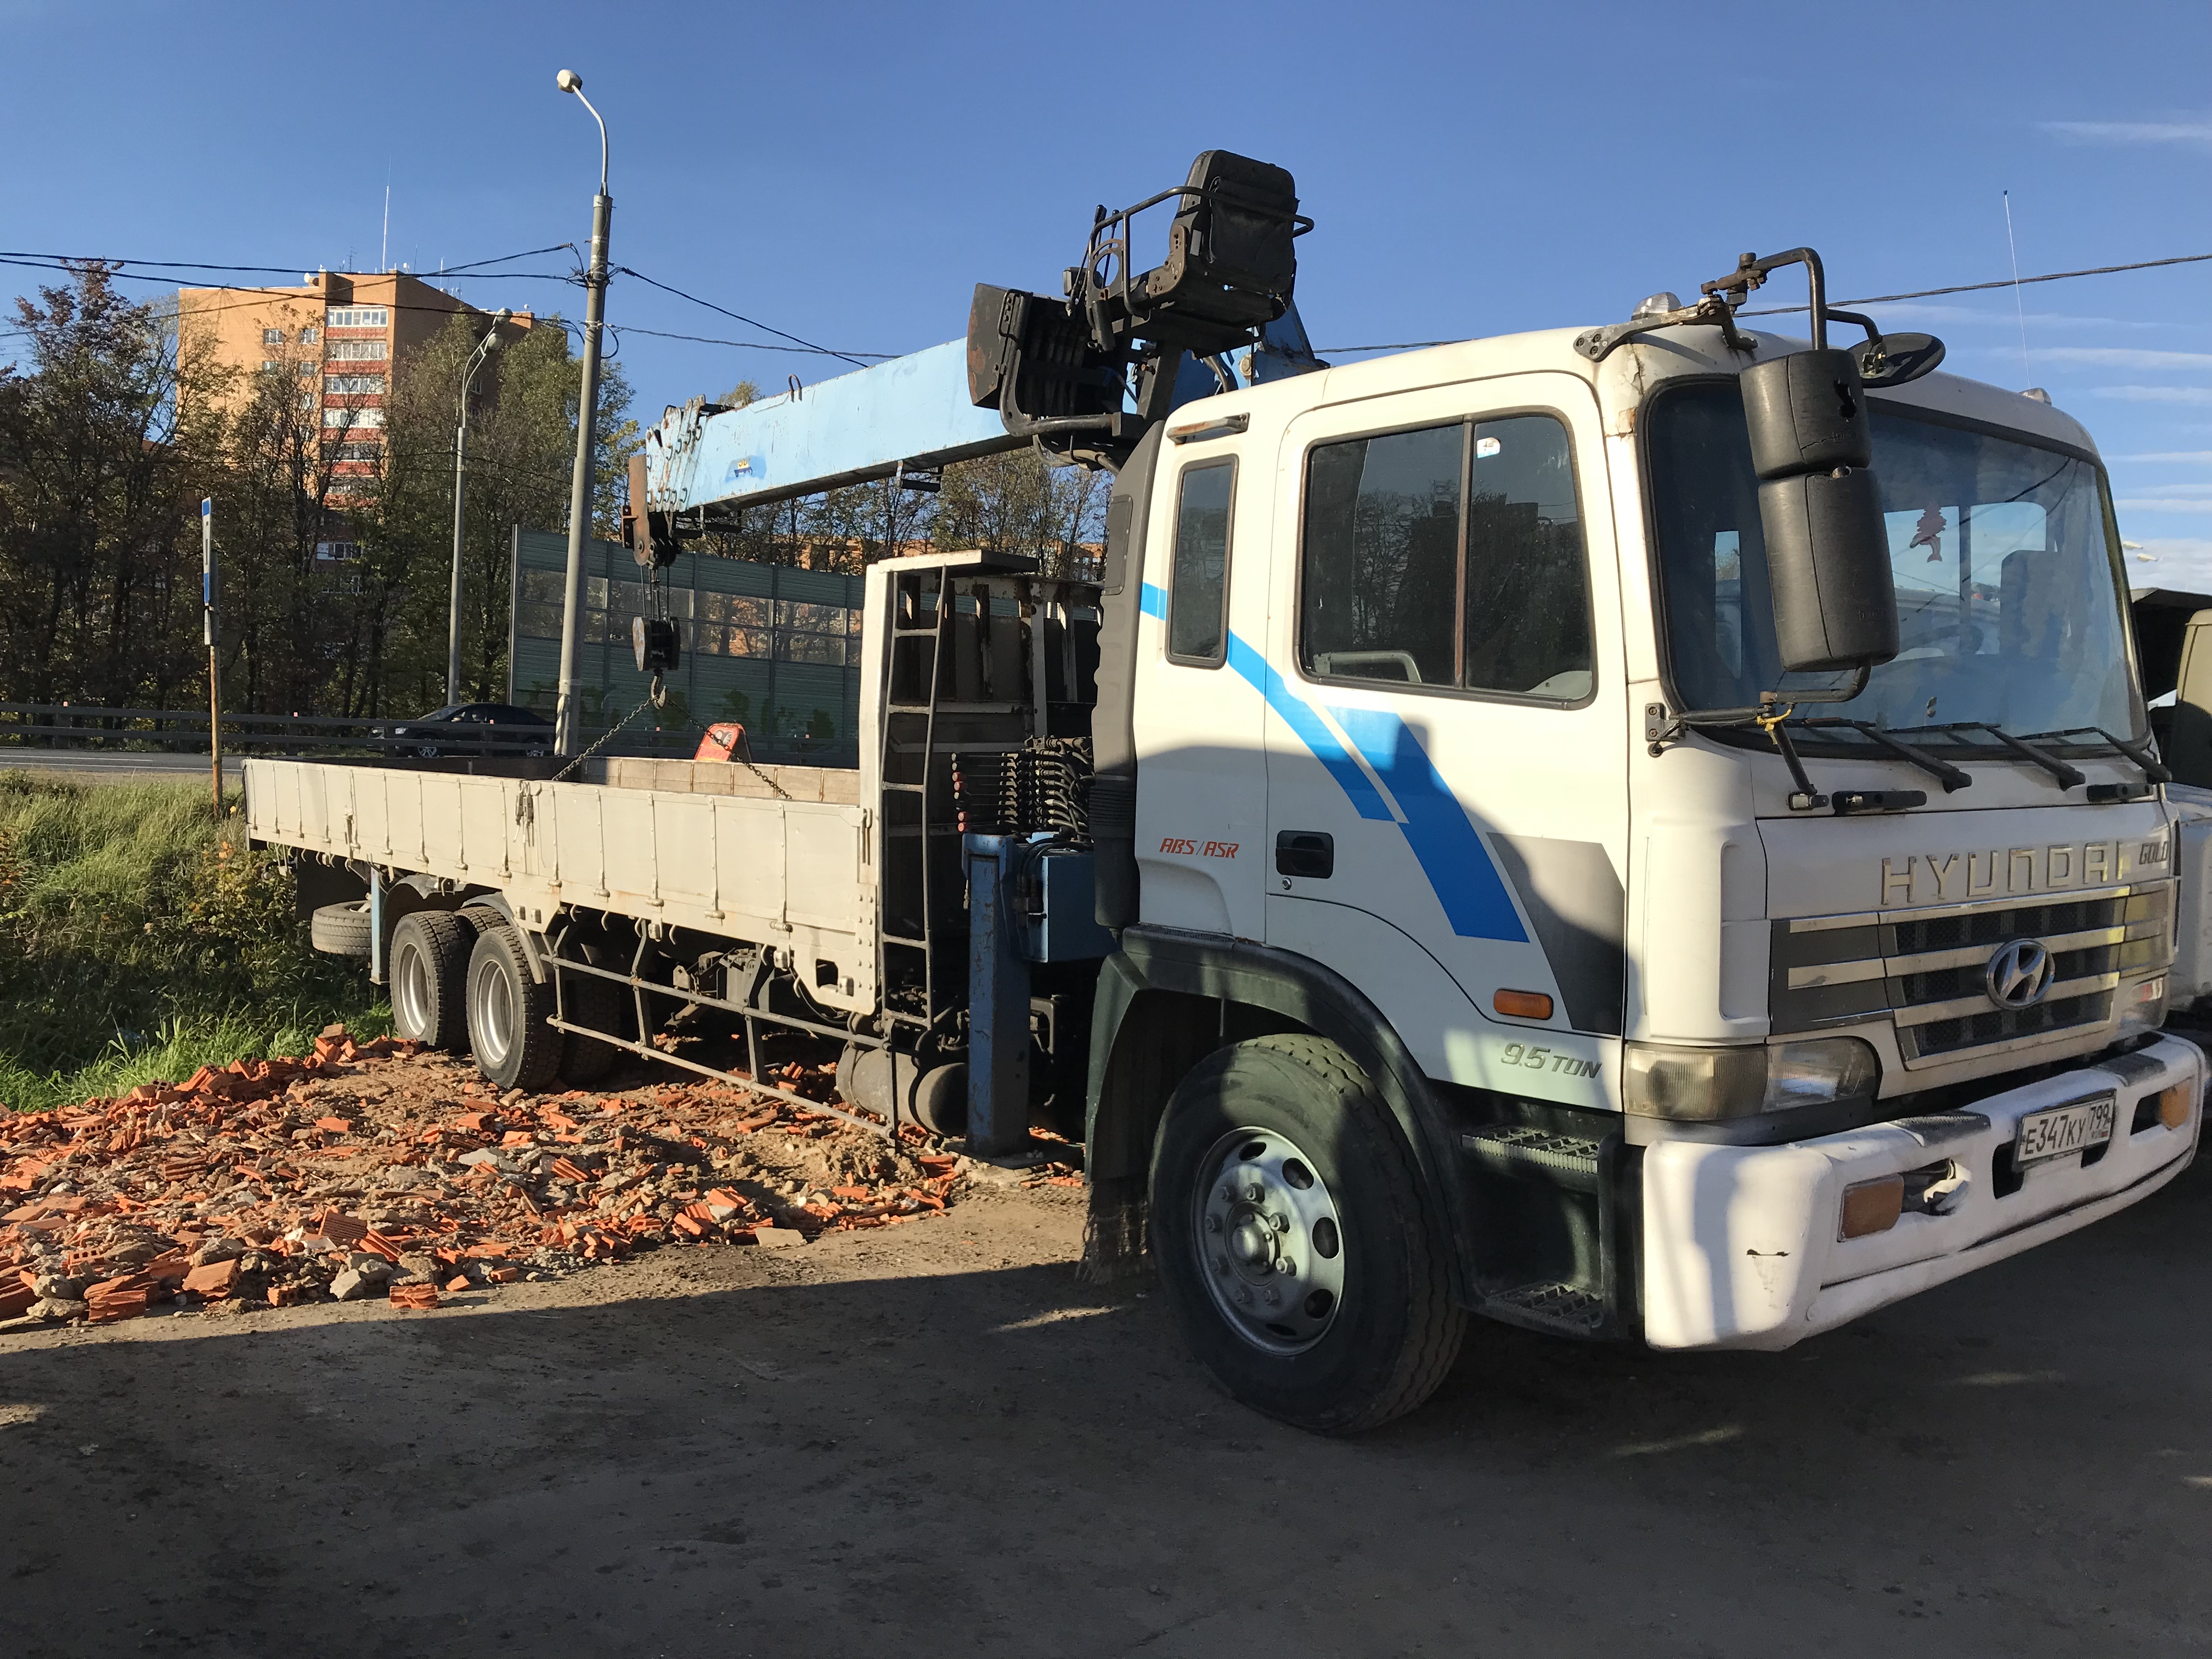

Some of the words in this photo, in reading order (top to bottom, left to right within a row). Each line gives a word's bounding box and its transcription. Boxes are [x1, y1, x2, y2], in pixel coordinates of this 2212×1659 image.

[1159, 838, 1239, 859] ABS/ASR
[2138, 840, 2169, 865] GOLD
[1881, 840, 2123, 905] HYUNDAI
[1551, 1055, 1602, 1079] TON
